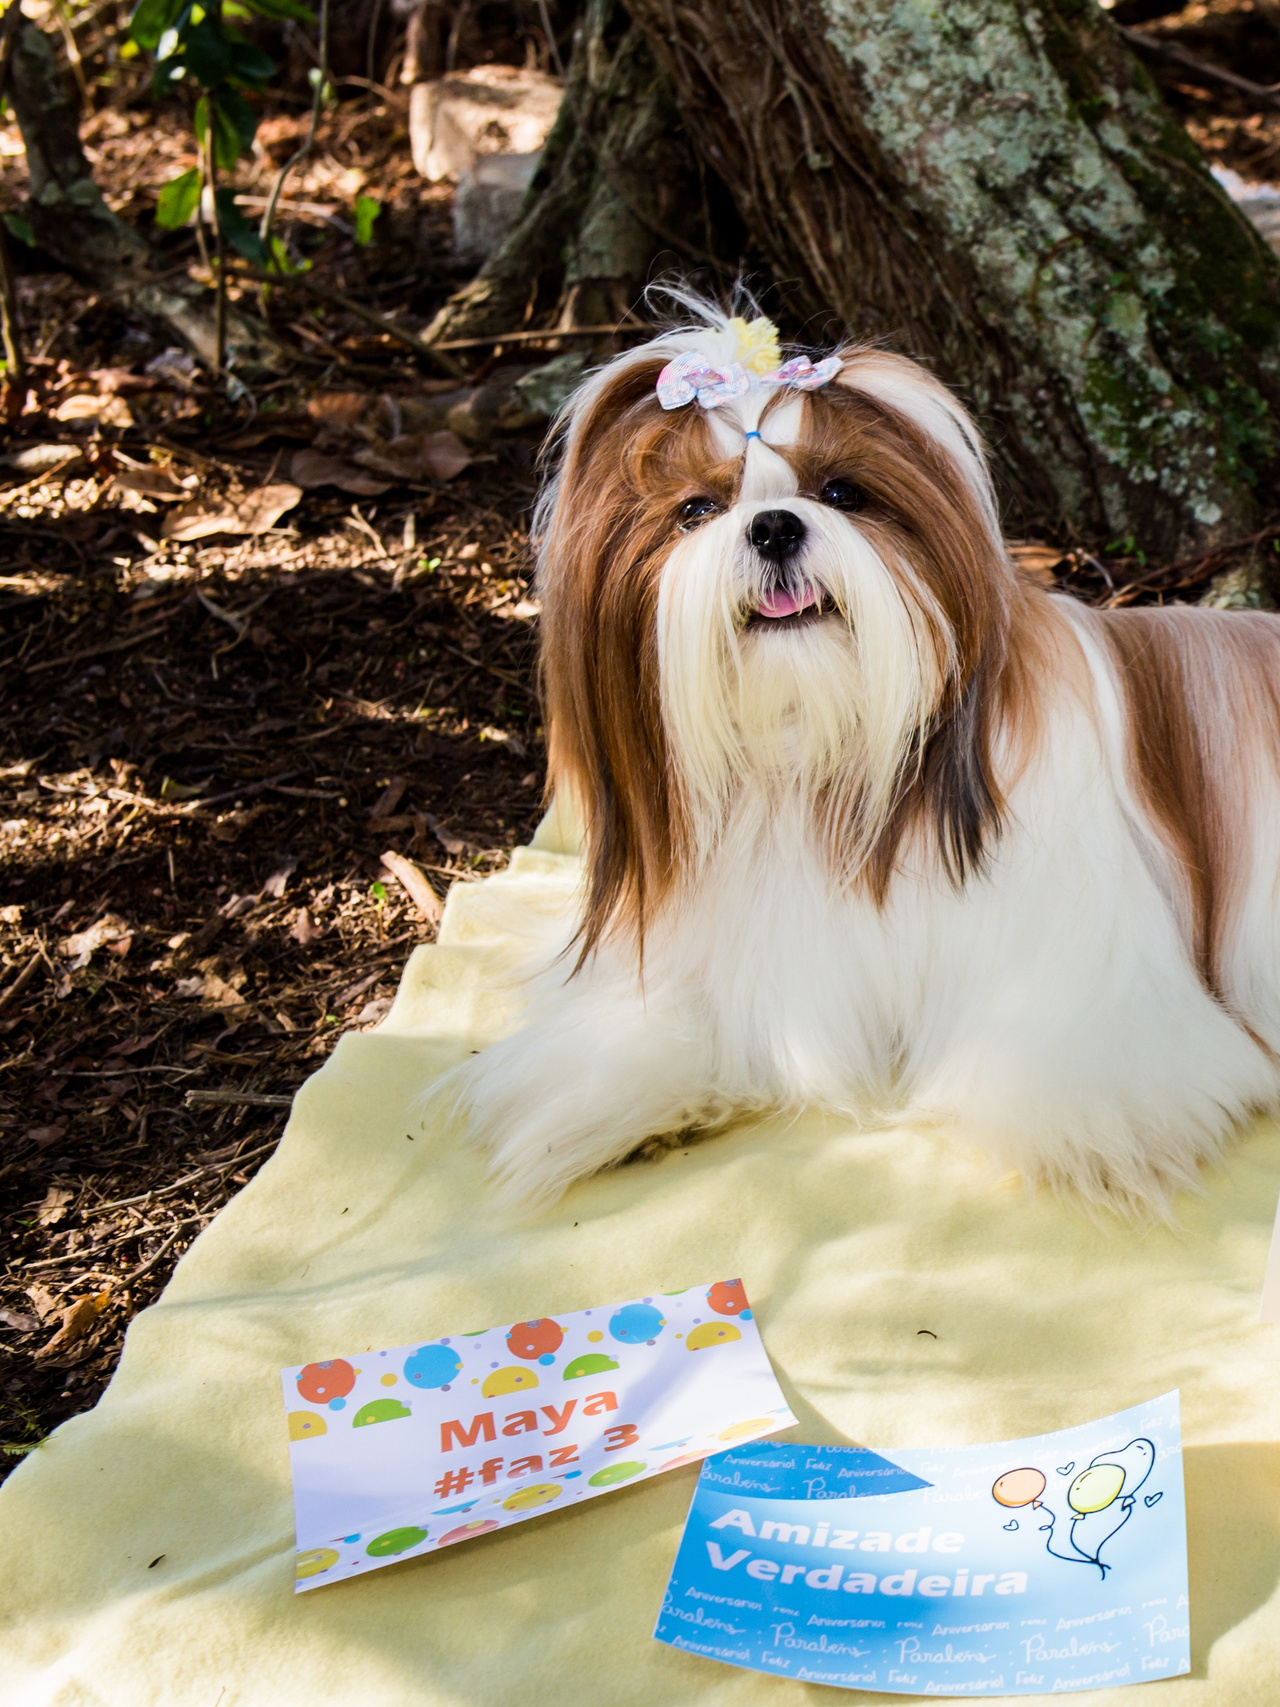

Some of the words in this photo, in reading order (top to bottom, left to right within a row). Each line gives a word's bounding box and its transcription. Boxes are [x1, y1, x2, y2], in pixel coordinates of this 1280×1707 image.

[440, 1391, 619, 1453] Maya
[433, 1444, 580, 1499] #faz
[603, 1423, 640, 1453] 3
[710, 1508, 966, 1554] Amizade
[706, 1542, 1028, 1597] Verdadeira
